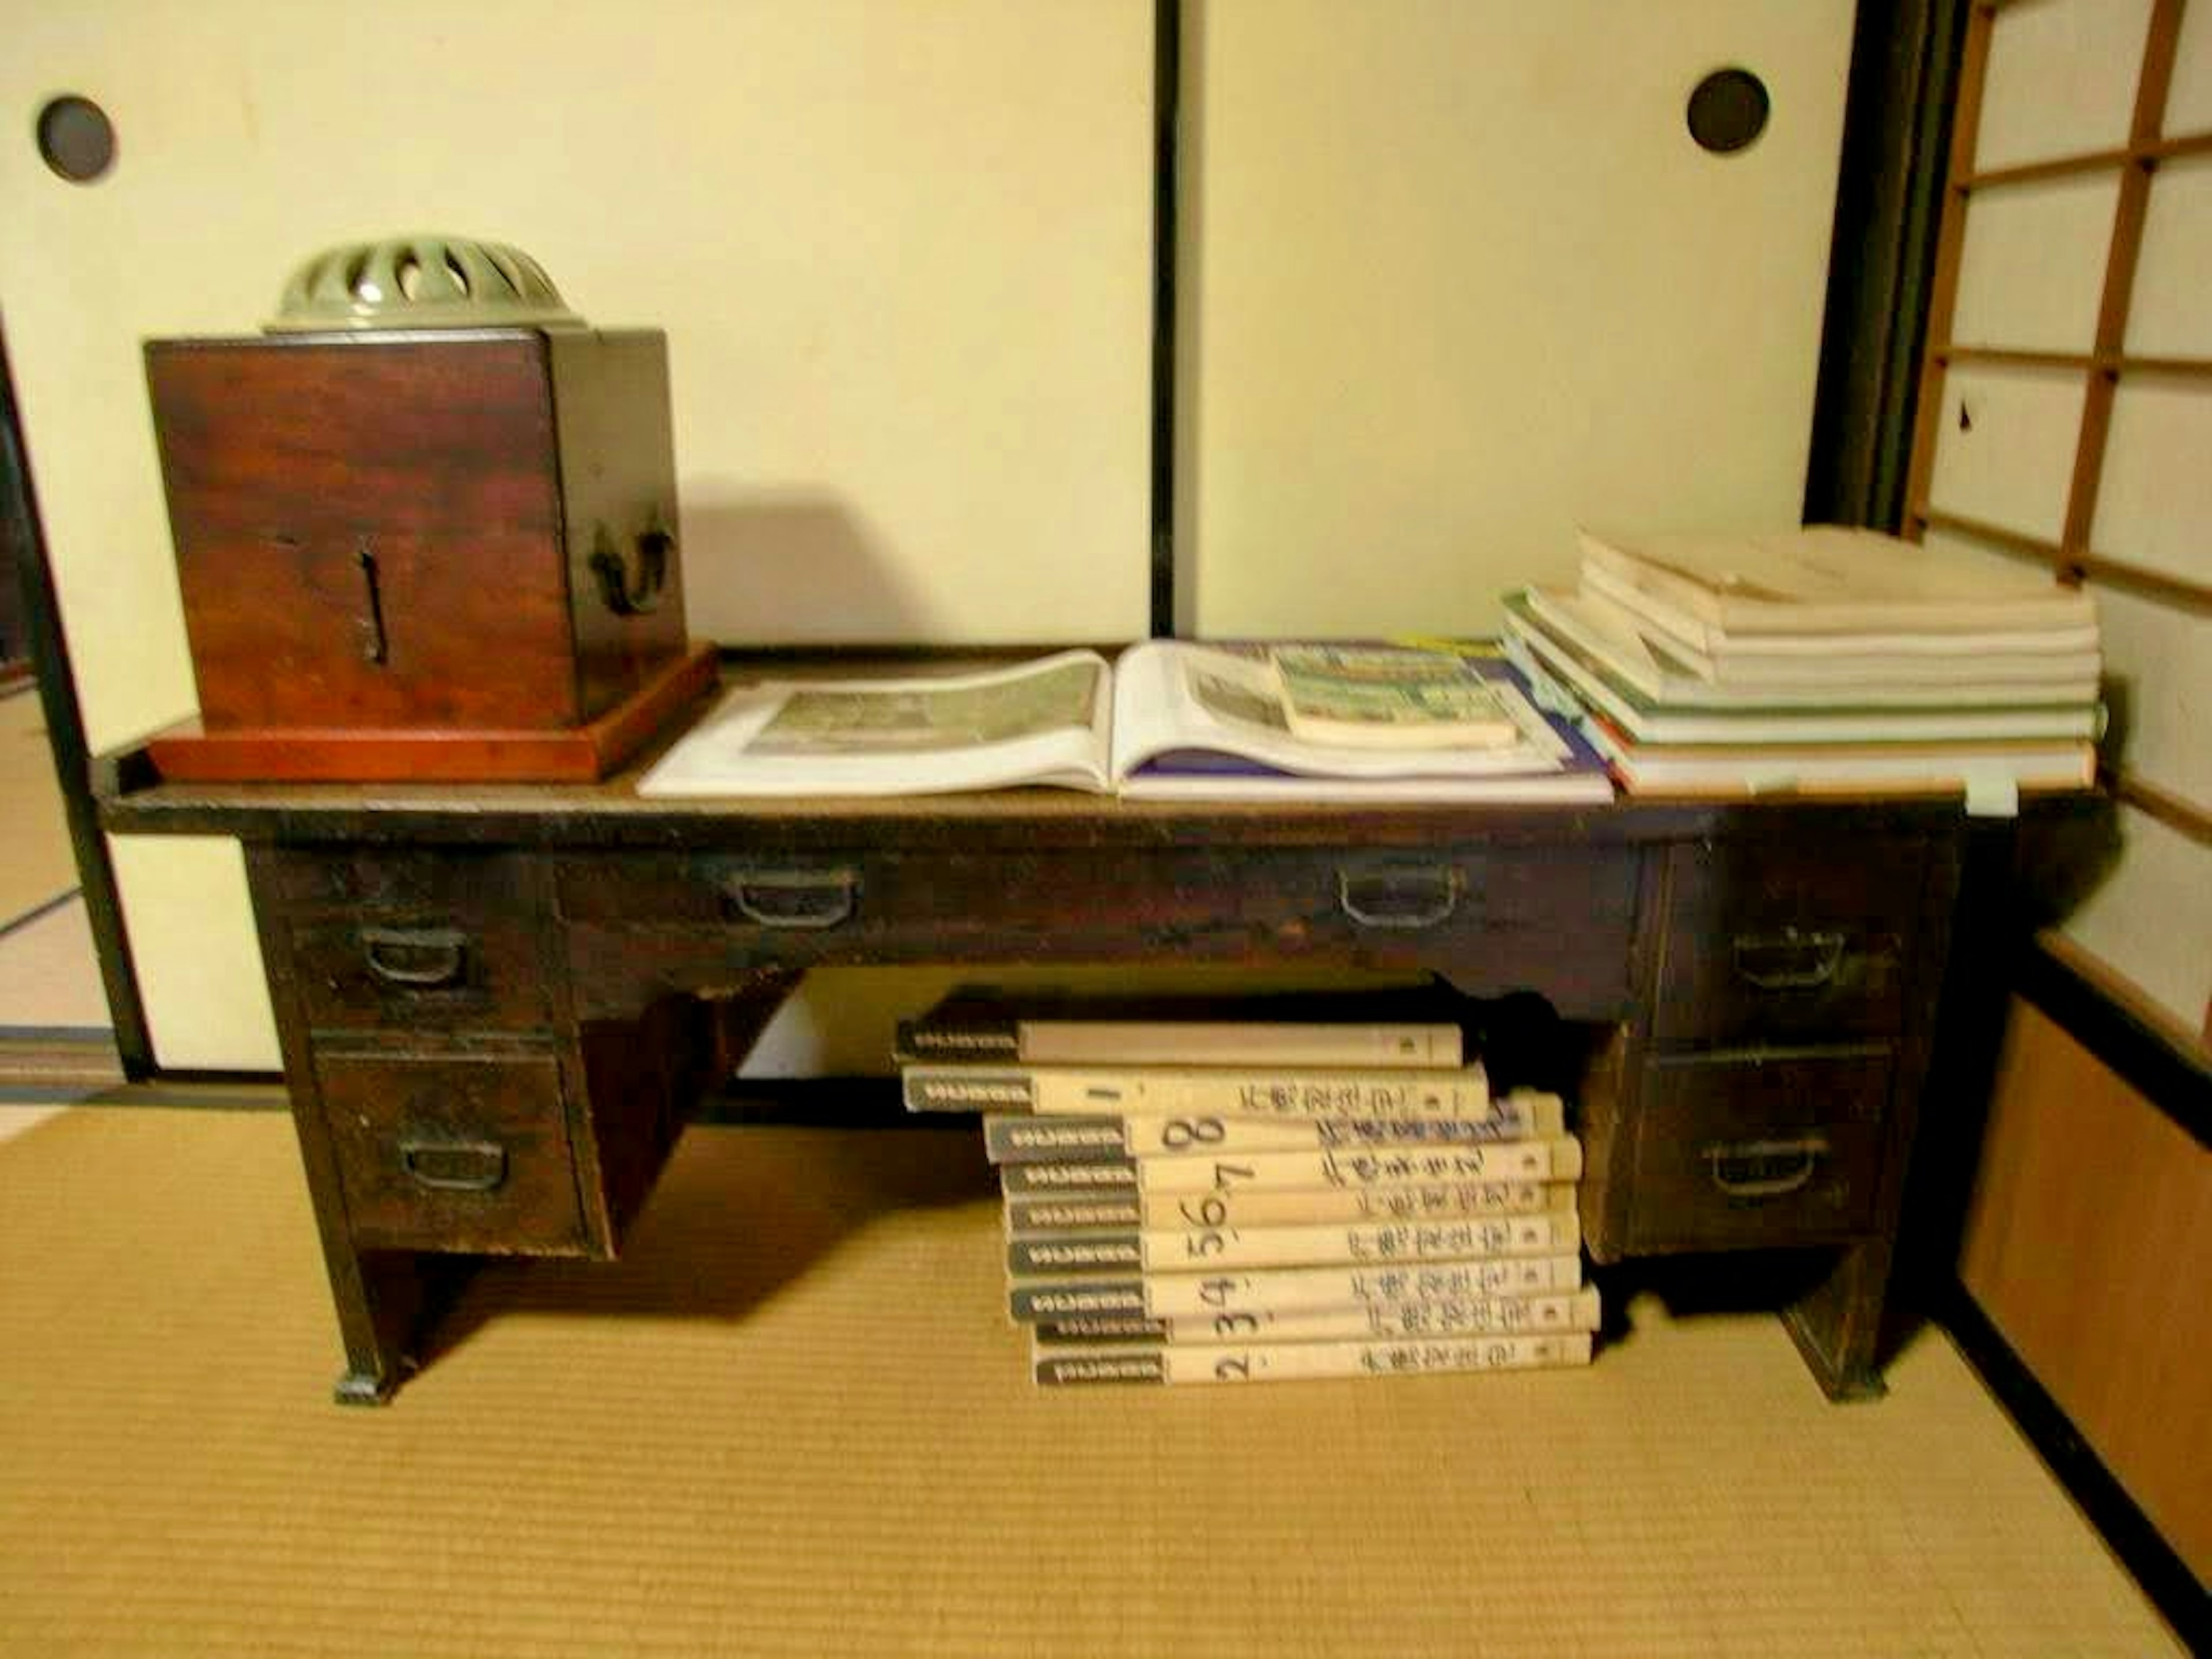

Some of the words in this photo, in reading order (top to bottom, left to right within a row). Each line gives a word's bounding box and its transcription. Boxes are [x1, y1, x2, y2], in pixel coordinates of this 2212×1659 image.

[1162, 1118, 1226, 1151] 8
[1215, 1162, 1255, 1190] 7
[1178, 1195, 1227, 1227] 6
[1187, 1232, 1225, 1259] 5
[1215, 1310, 1258, 1338] 3
[1215, 1353, 1249, 1382] 2
